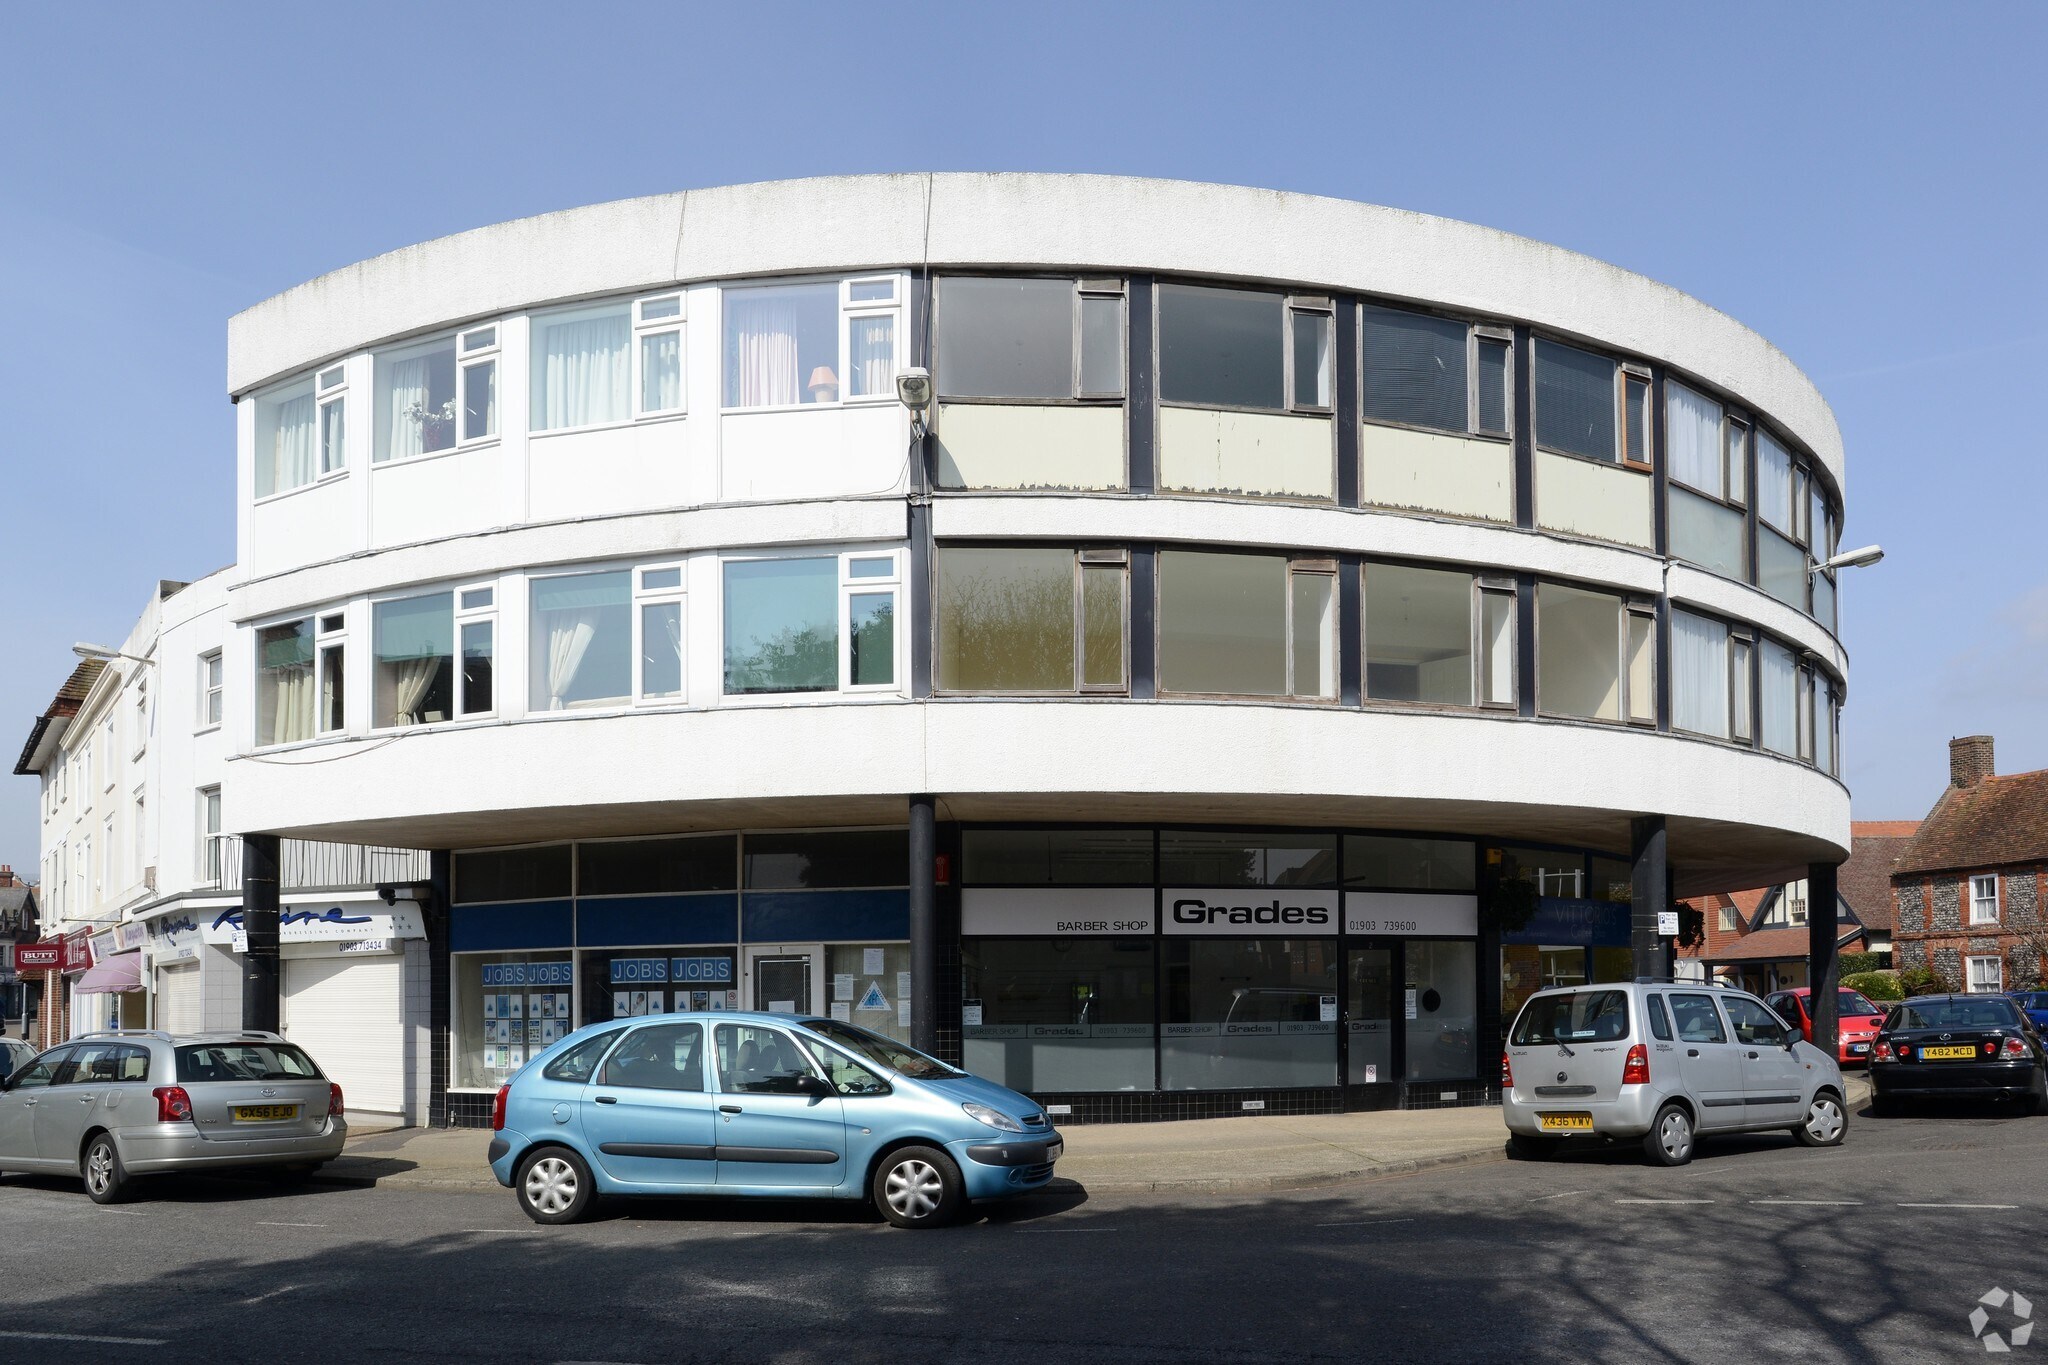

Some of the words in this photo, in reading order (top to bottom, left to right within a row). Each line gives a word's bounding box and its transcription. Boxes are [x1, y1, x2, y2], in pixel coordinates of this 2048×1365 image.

[1173, 899, 1329, 924] Grades
[212, 905, 372, 932] Rine
[1057, 921, 1109, 931] BARBER
[1113, 920, 1149, 931] SHOP
[1349, 920, 1376, 931] 01903
[1384, 921, 1417, 931] 739600
[339, 942, 358, 951] 01903
[359, 941, 382, 950] 713434
[484, 967, 525, 983] JOBS
[529, 966, 571, 982] JOBS
[614, 963, 666, 979] JOBS
[675, 962, 729, 978] JOBS
[1167, 1026, 1193, 1034] BARBER
[1227, 1025, 1273, 1033] Grades
[1925, 1047, 1951, 1057] Y482
[1953, 1047, 1973, 1056] MCD
[240, 1107, 270, 1118] GX56
[1543, 1116, 1569, 1126] X436
